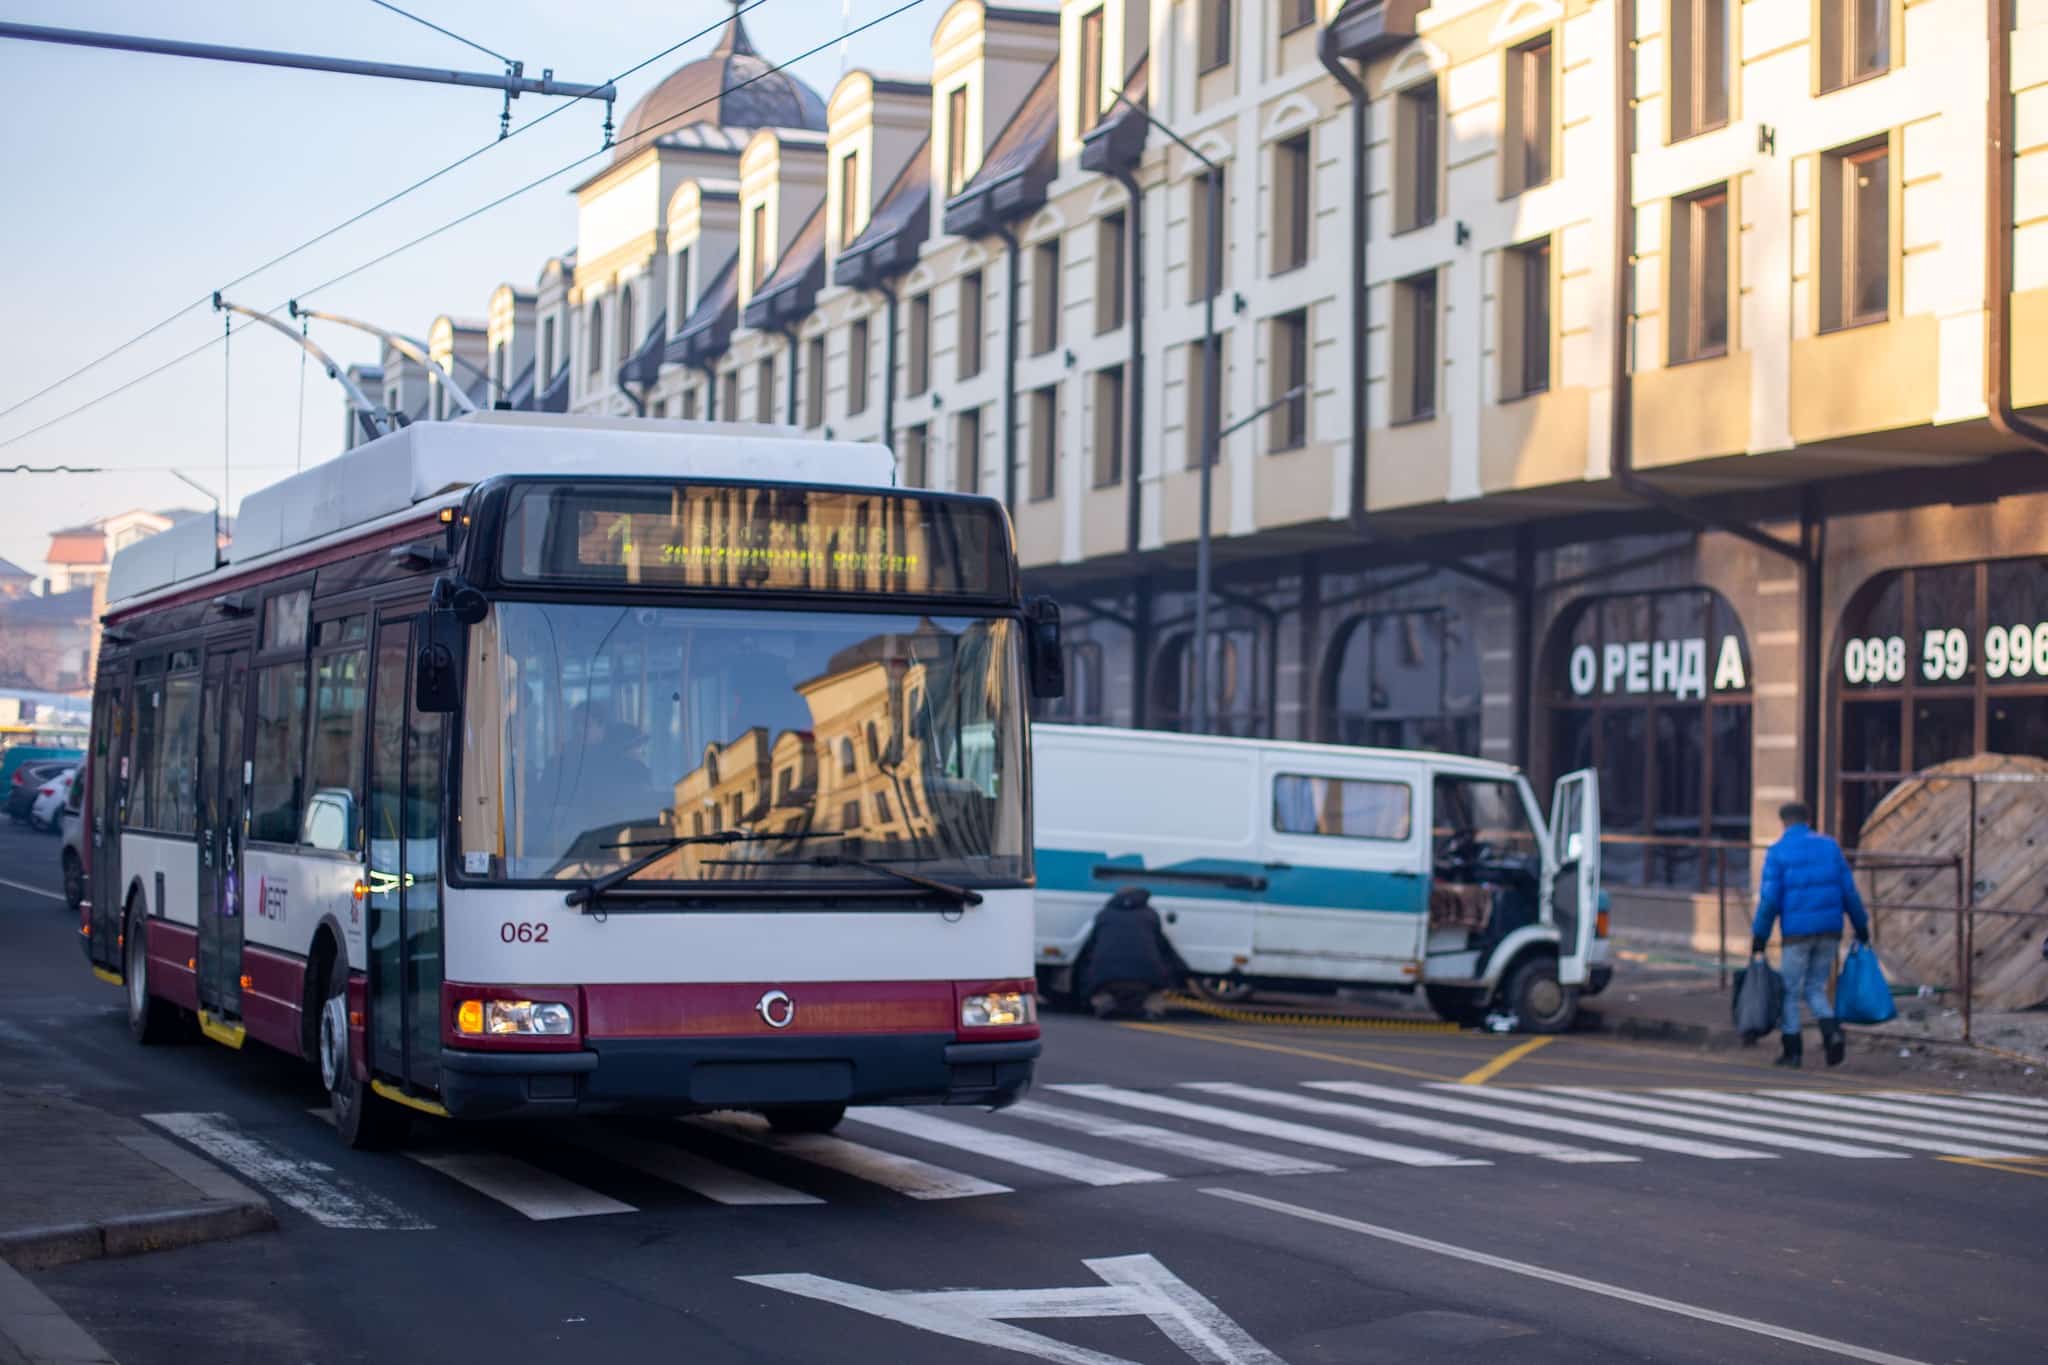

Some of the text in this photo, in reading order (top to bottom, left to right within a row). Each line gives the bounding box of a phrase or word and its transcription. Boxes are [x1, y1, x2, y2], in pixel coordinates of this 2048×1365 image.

[1844, 636, 1906, 684] 098
[1922, 628, 1969, 681] 59
[500, 922, 549, 943] 062
